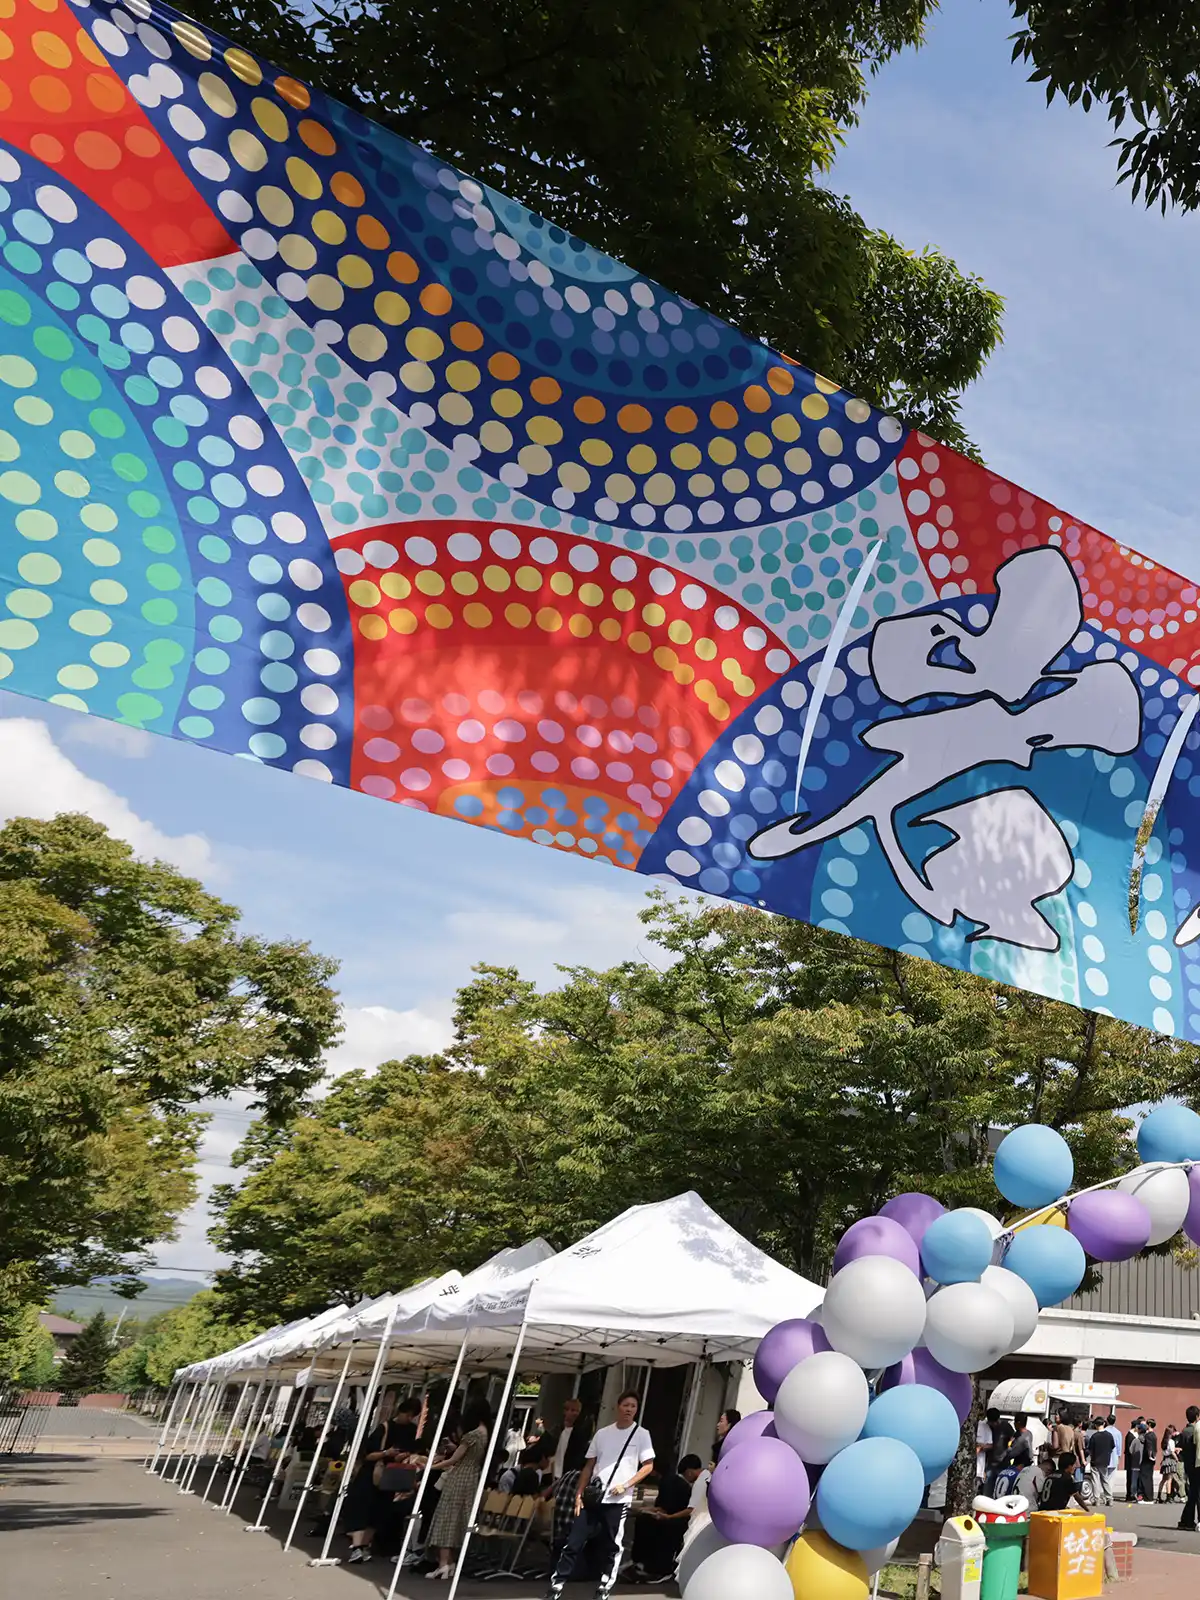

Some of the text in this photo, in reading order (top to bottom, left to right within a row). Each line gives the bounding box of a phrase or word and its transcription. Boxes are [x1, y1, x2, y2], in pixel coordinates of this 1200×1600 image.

[1042, 1479, 1053, 1502] 8
[1063, 1528, 1105, 1554] もえる
[1067, 1554, 1097, 1575] ゴミ
